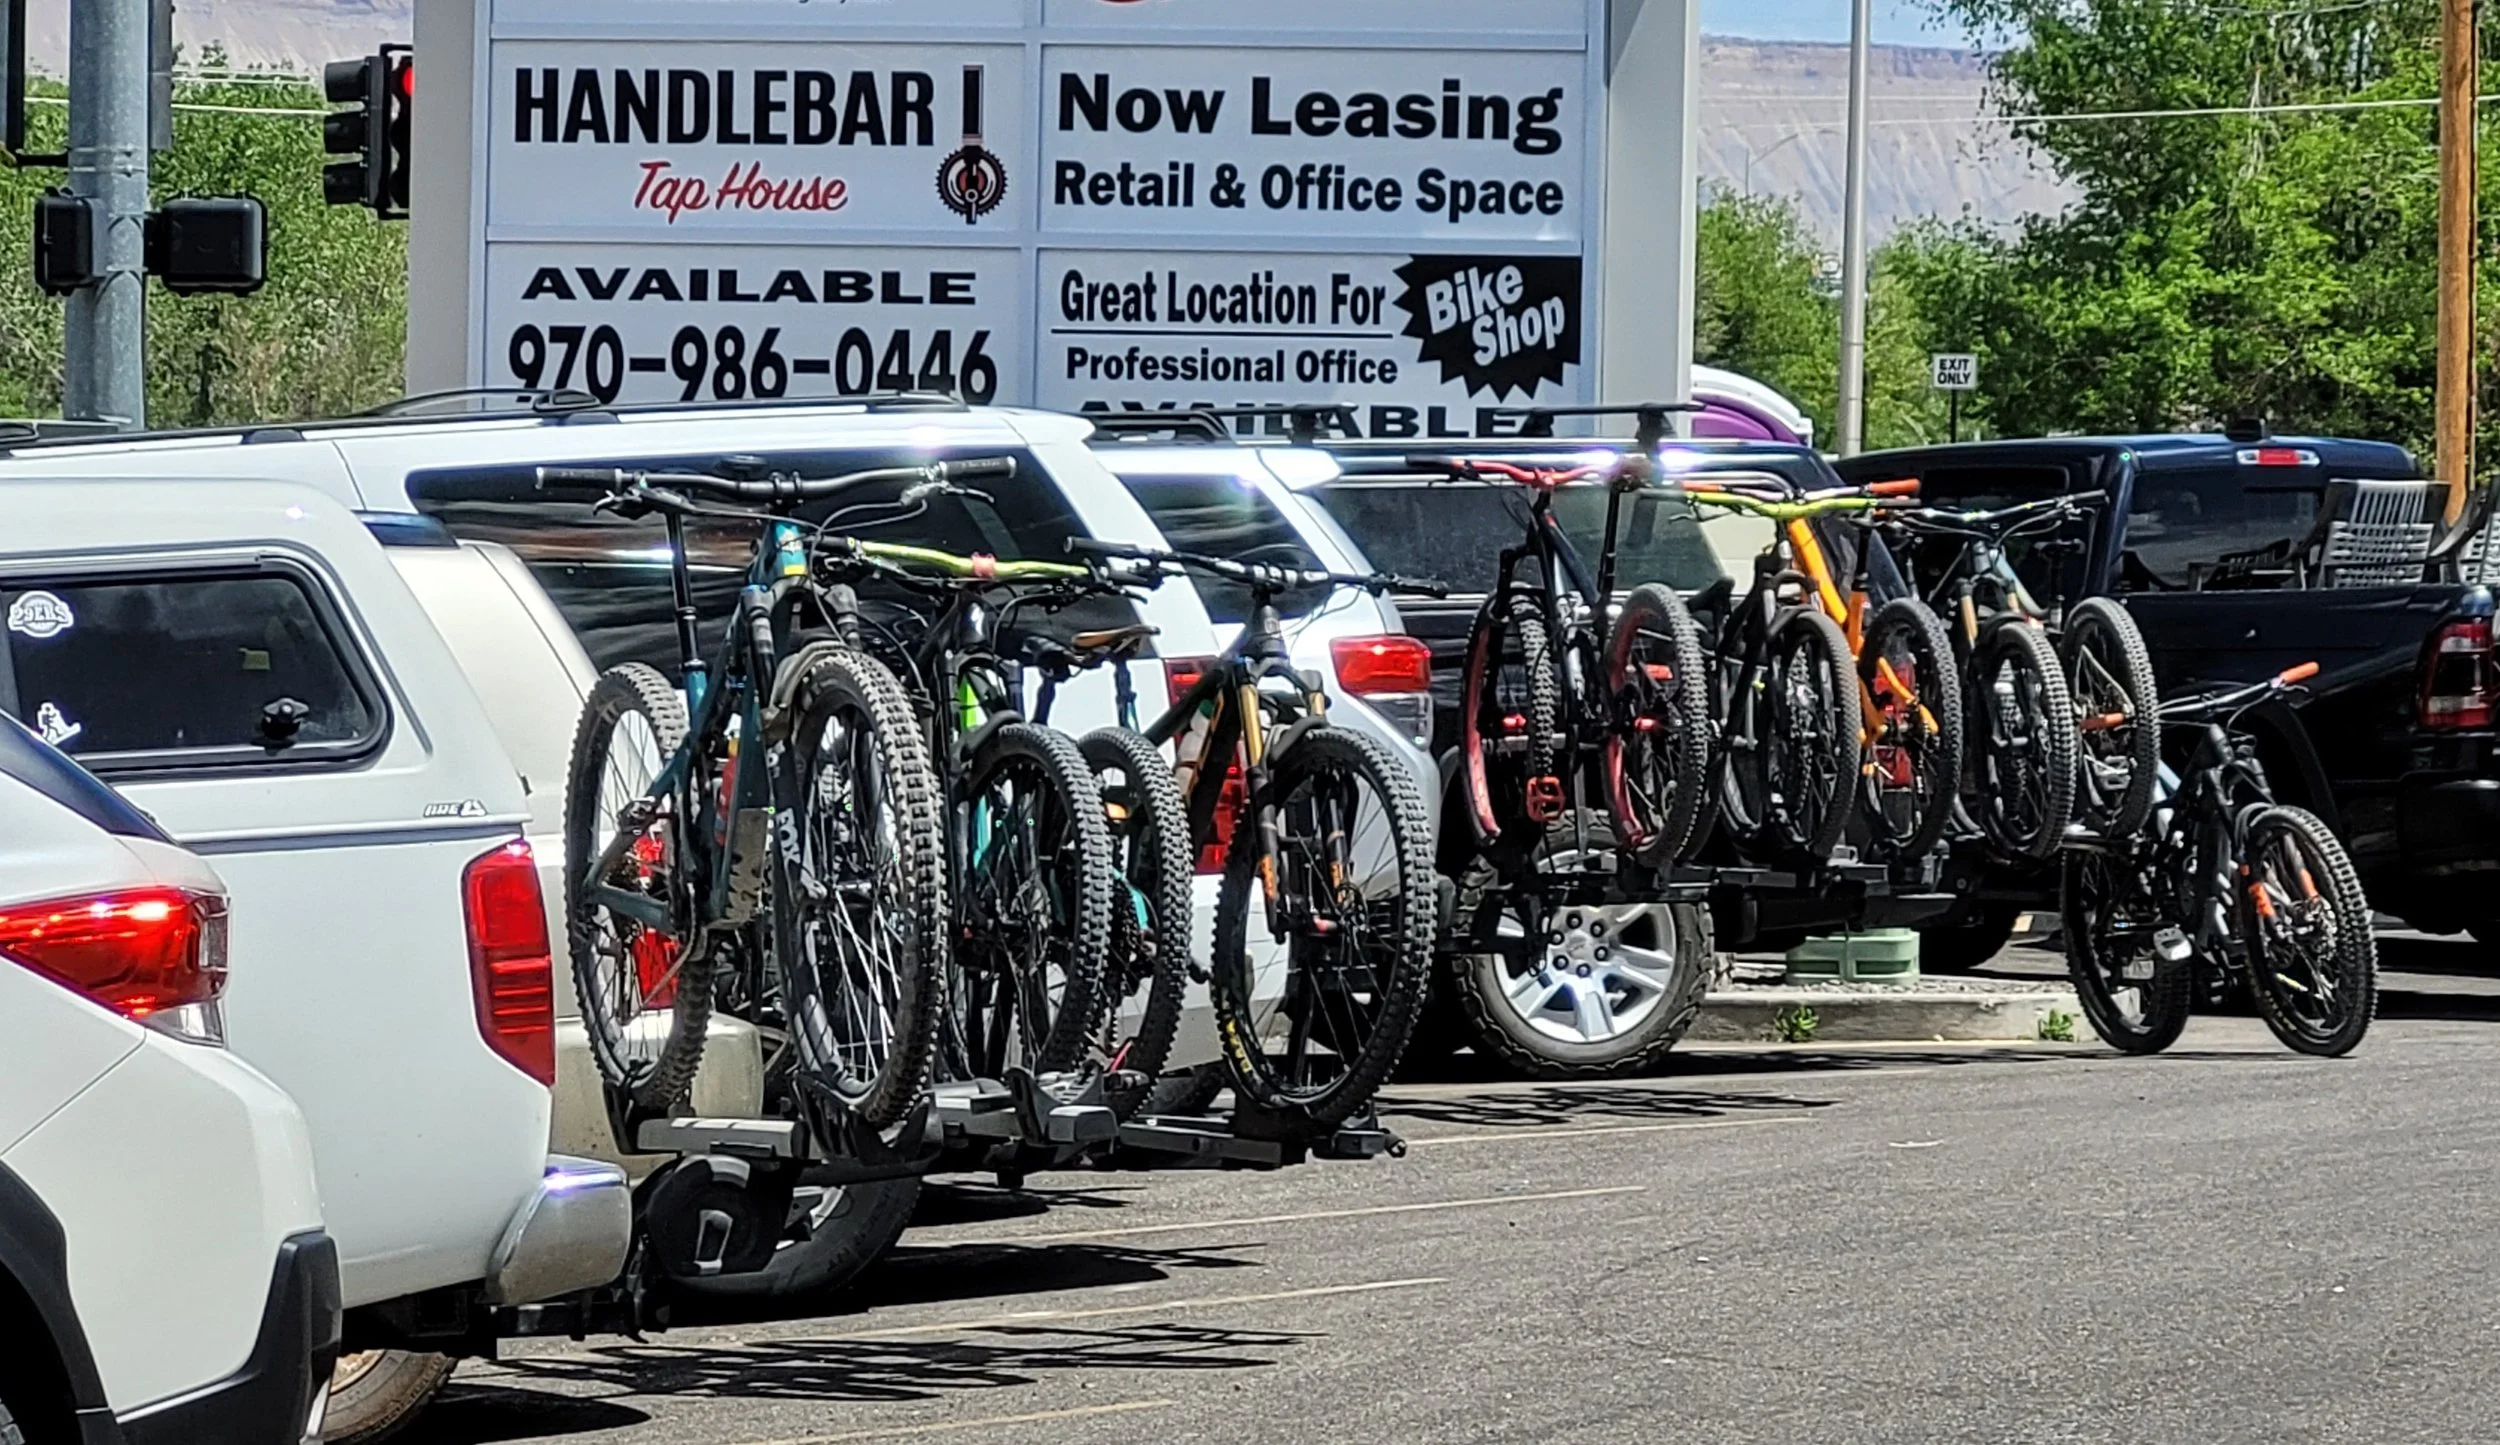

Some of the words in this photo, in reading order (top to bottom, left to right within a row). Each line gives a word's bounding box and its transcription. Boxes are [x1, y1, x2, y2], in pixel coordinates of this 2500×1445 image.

[514, 68, 935, 146] HANDLEBAR
[1058, 72, 1225, 134] Now
[1251, 76, 1564, 156] Leasing
[633, 161, 711, 224] Tap
[714, 161, 849, 211] House
[1054, 160, 1195, 208] Retail
[1210, 164, 1246, 209] &
[1260, 163, 1402, 212] Office
[1415, 168, 1564, 223] Space
[520, 267, 977, 305] AVAILABLE
[1061, 269, 1157, 325] Great
[1167, 270, 1317, 325] Location
[1330, 273, 1386, 326] For
[1425, 264, 1524, 335] Bike
[1471, 296, 1566, 367] Shop
[508, 323, 998, 406] 970-986-0446
[1066, 346, 1285, 384] Professional
[1295, 350, 1398, 384] Office
[1937, 372, 1972, 384] ONLY
[1939, 359, 1970, 370] EXIT
